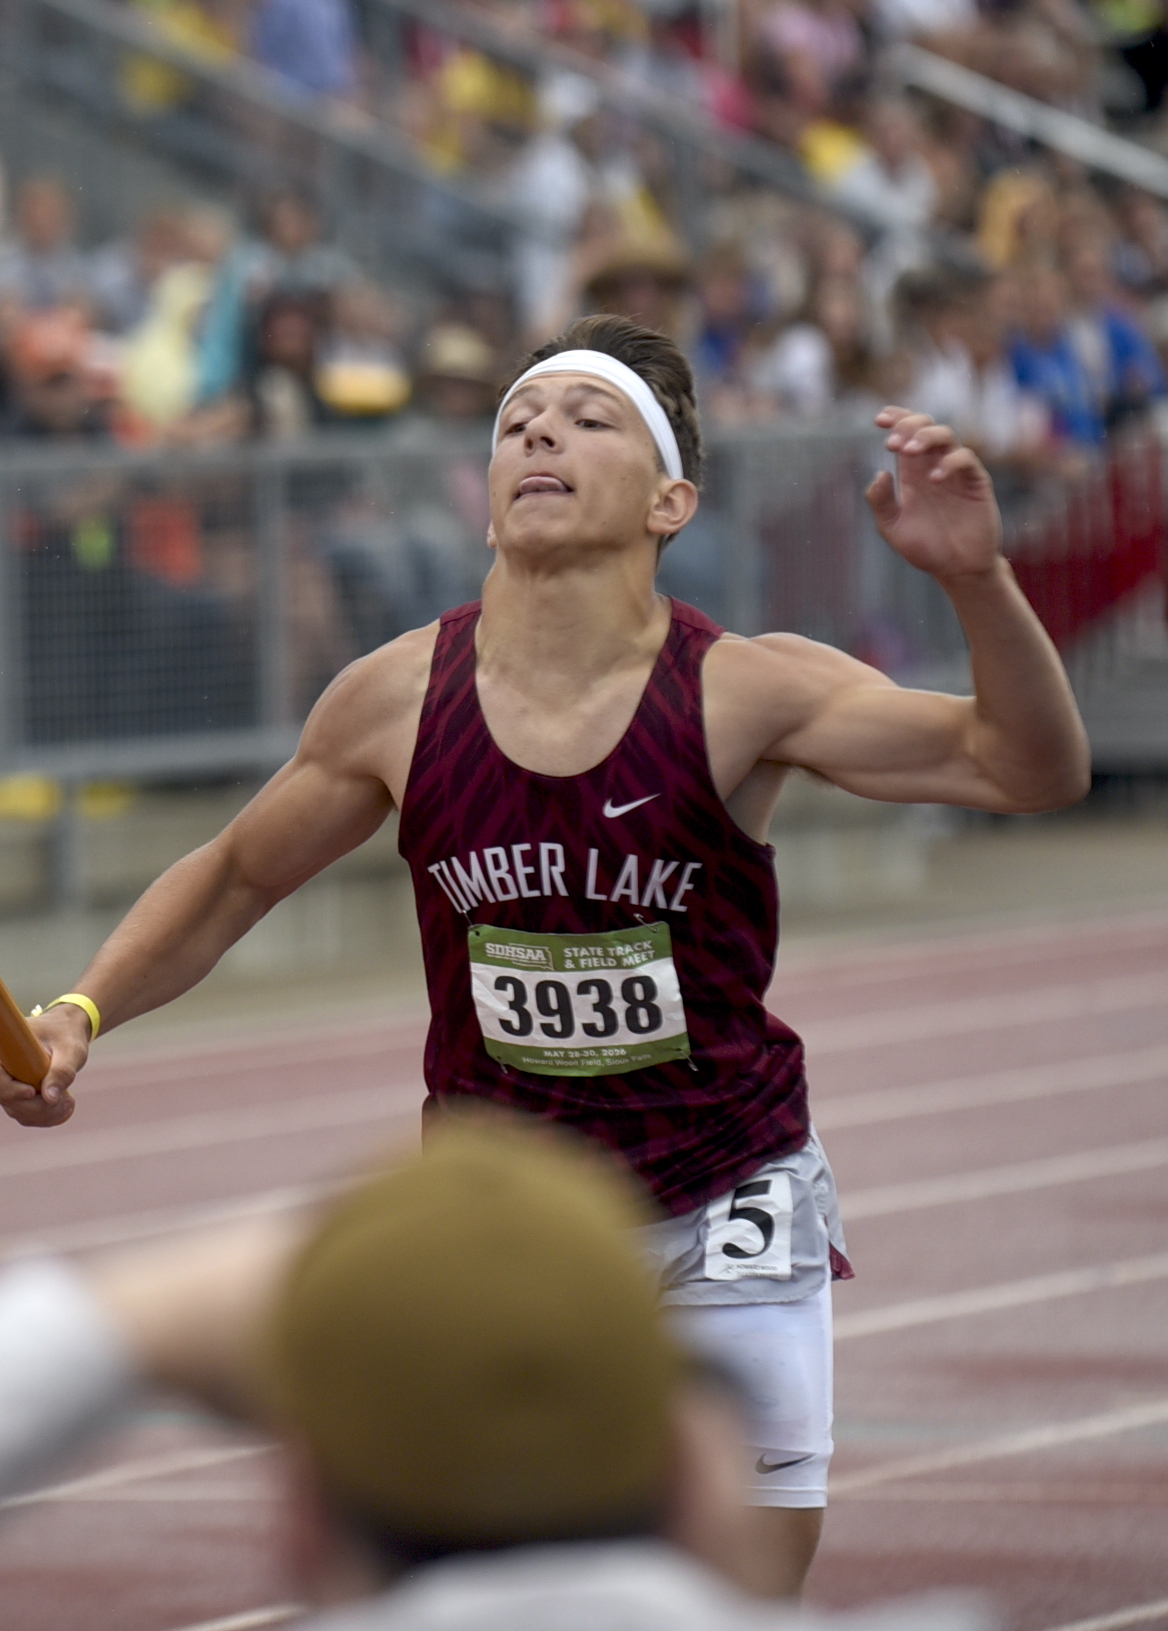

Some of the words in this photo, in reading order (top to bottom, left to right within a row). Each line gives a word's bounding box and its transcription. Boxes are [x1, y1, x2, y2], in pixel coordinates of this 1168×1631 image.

[427, 842, 569, 914] TIMBER
[585, 848, 703, 912] LAKE
[485, 942, 547, 961] SDHSAA
[564, 946, 604, 958] STATE
[608, 940, 653, 957] TRACK
[564, 958, 576, 969] &
[580, 957, 617, 969] FIELD
[621, 950, 656, 967] MEET
[493, 975, 663, 1039] 3938
[522, 1056, 553, 1066] Howard
[555, 1058, 579, 1066] Wood
[581, 1058, 605, 1067] Field,
[606, 1057, 630, 1066] Sioux
[632, 1053, 652, 1063] Falls
[543, 1050, 565, 1058] MAY
[722, 1179, 775, 1259] 5
